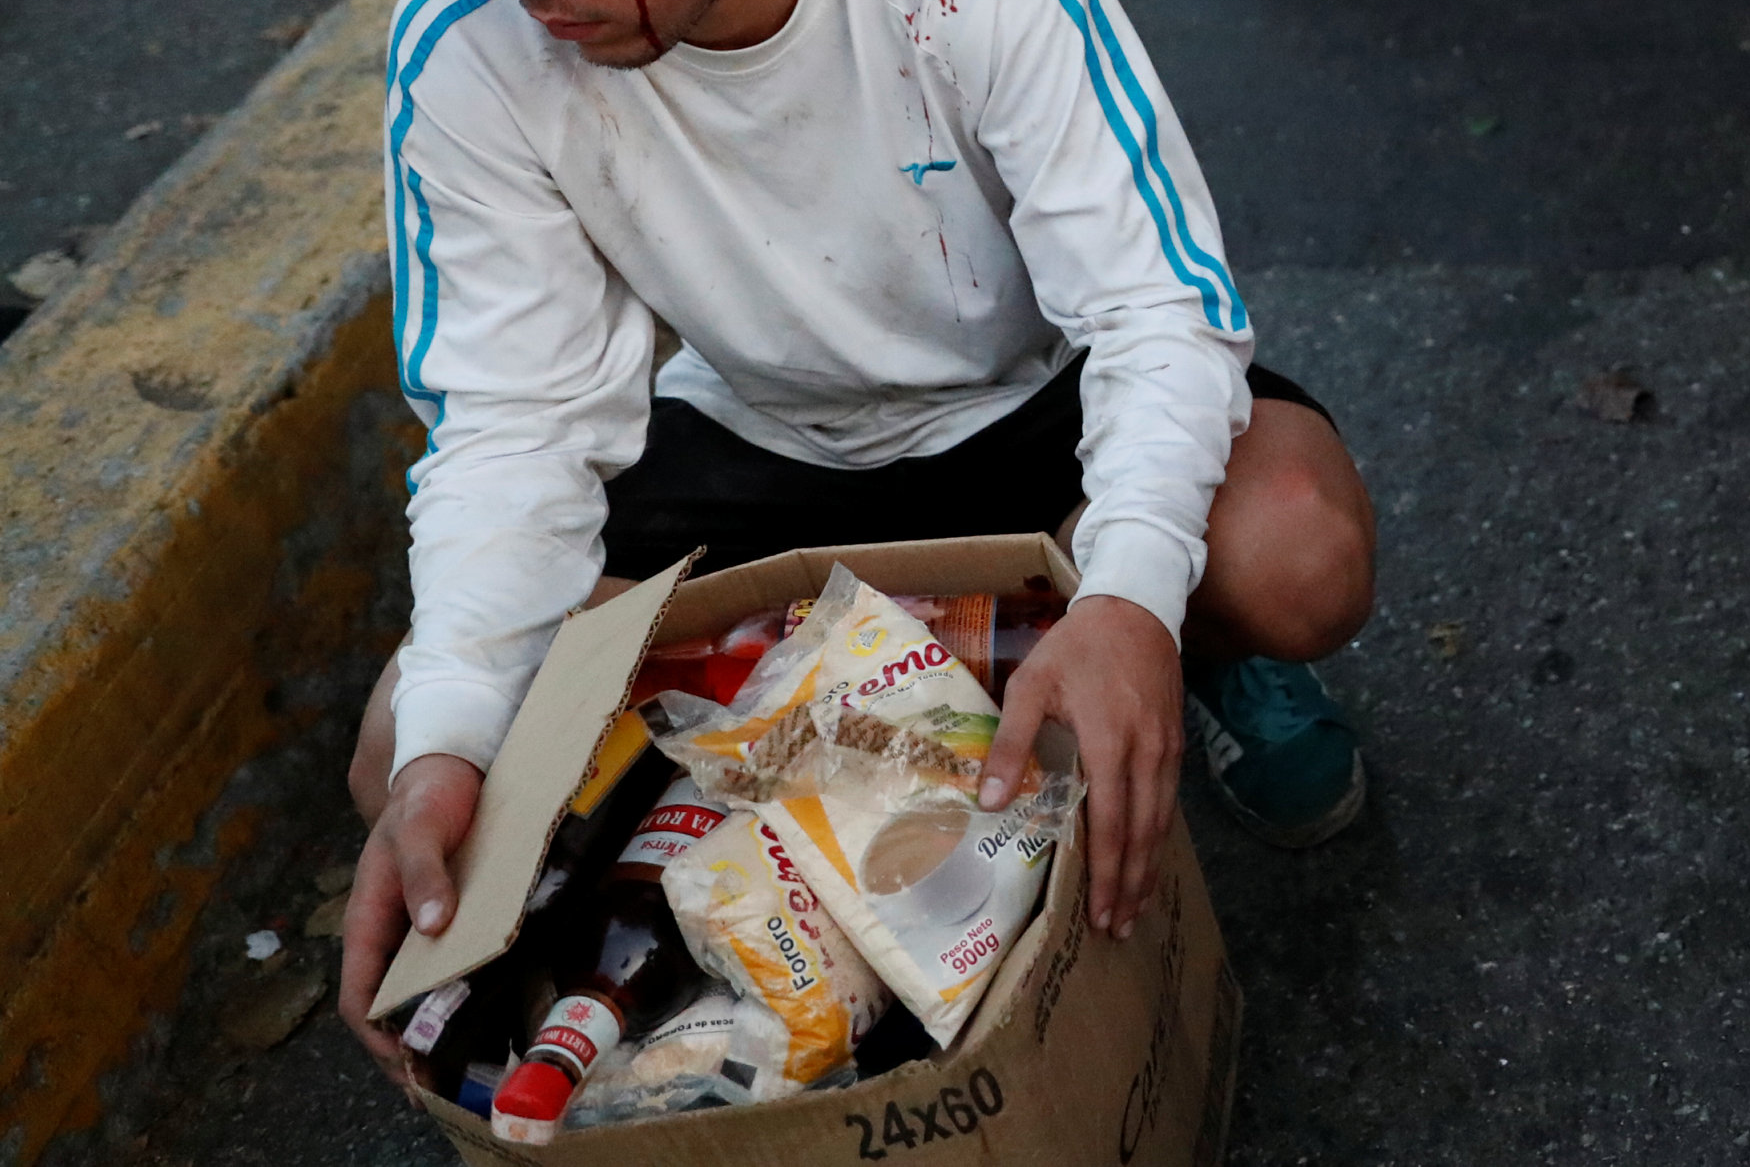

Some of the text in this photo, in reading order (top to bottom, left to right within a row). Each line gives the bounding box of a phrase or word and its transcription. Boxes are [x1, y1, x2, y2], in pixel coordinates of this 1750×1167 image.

[767, 916, 815, 991] Fororo
[940, 918, 993, 964] Peso Neto
[952, 932, 1000, 975] 900g
[694, 1019, 707, 1028] de
[845, 1066, 1004, 1162] 24x60
